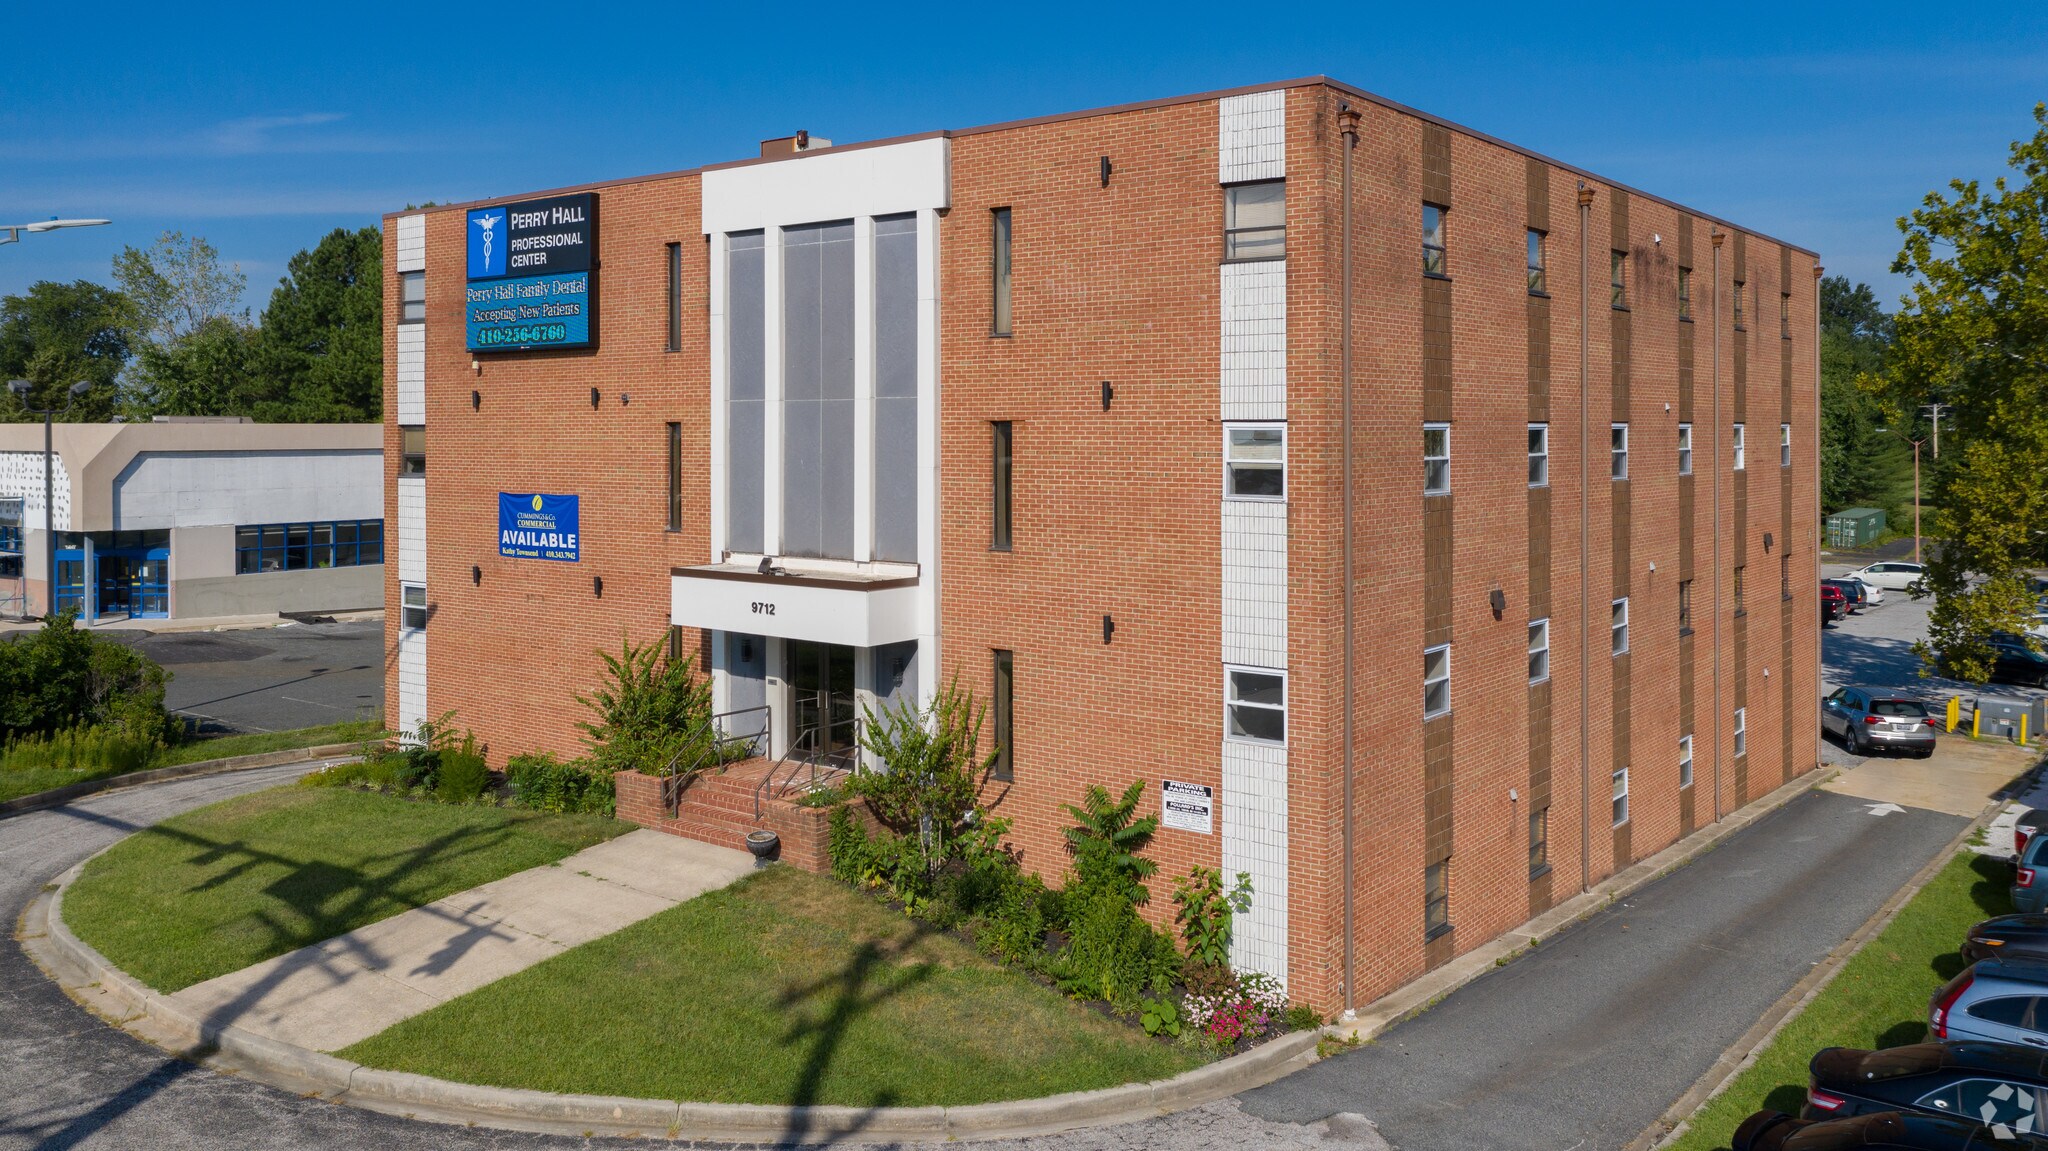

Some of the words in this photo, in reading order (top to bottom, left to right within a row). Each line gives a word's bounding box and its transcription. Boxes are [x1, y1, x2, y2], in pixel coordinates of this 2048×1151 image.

[512, 211, 548, 230] PERRY
[552, 207, 584, 225] HALL
[512, 232, 583, 252] PROFESSIONAL
[512, 252, 546, 267] CENTER
[467, 288, 492, 304] Perry
[495, 284, 514, 300] Hall
[516, 281, 550, 300] Family
[552, 277, 586, 296] Dental
[473, 307, 516, 323] Accepting
[519, 305, 540, 318] New
[542, 302, 580, 317] Patients
[478, 324, 565, 344] 410-256-6760
[518, 520, 556, 528] COMMERCIAL
[502, 530, 576, 548] AVAILABLE
[752, 602, 776, 616] 9712
[1168, 786, 1206, 796] PARKING
[1170, 782, 1204, 792] PRIVATE
